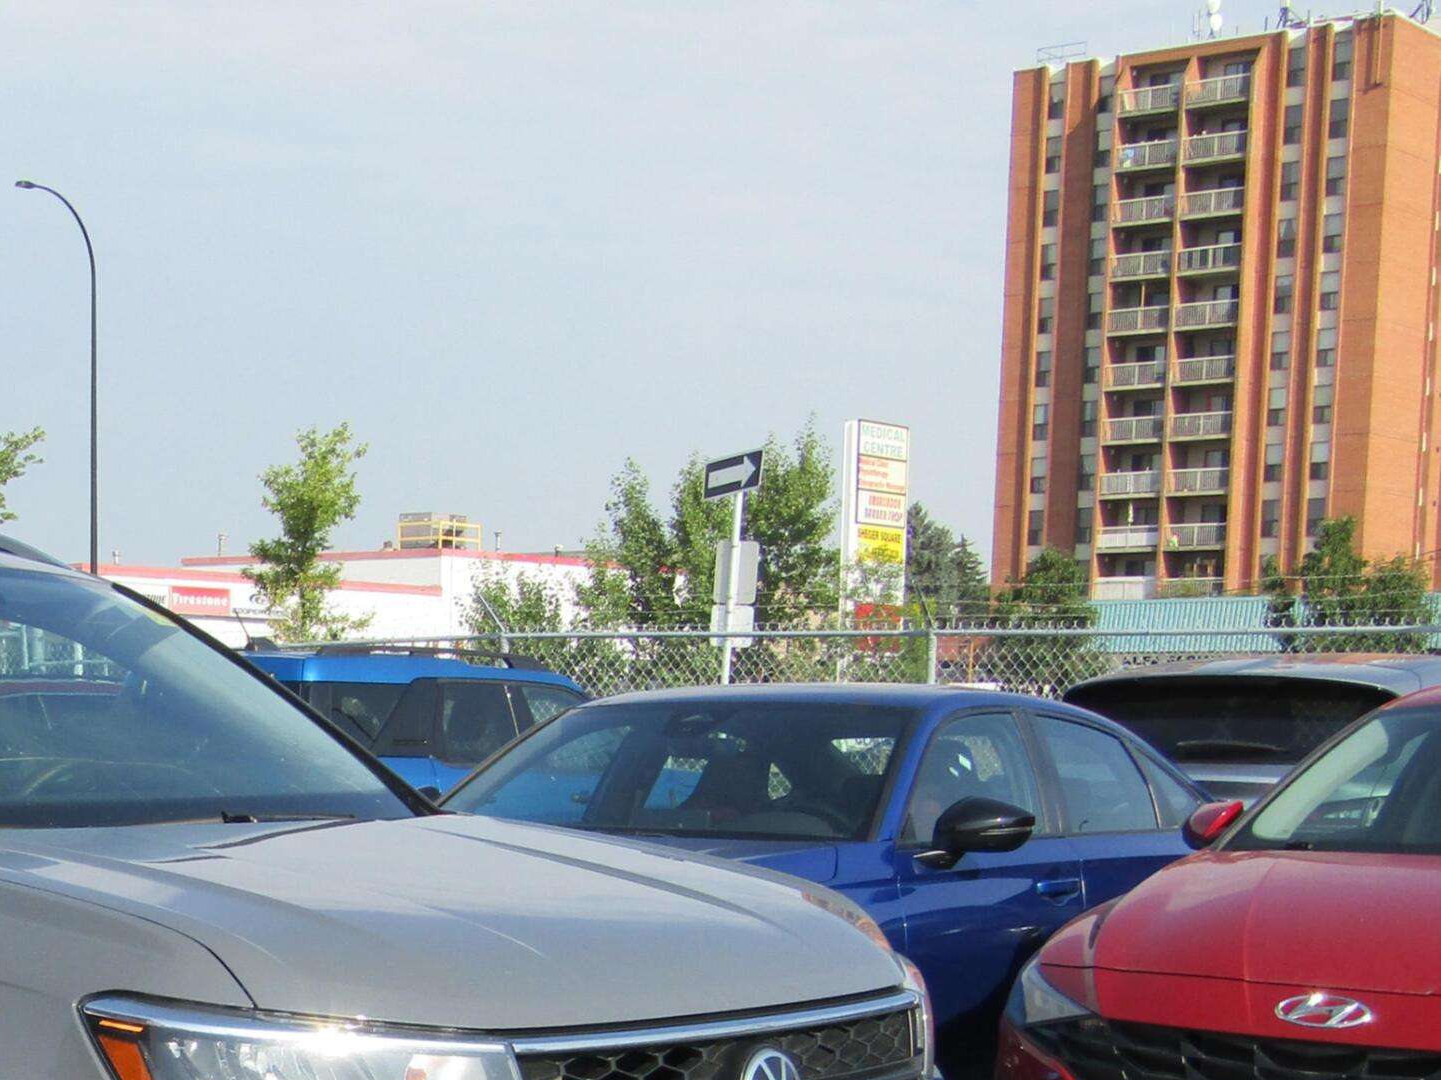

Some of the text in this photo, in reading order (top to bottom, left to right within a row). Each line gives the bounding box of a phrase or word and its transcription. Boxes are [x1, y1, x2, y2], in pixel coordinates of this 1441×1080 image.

[862, 424, 905, 442] MEDICAL
[863, 441, 903, 458] CENTRE
[172, 592, 229, 606] Firestone
